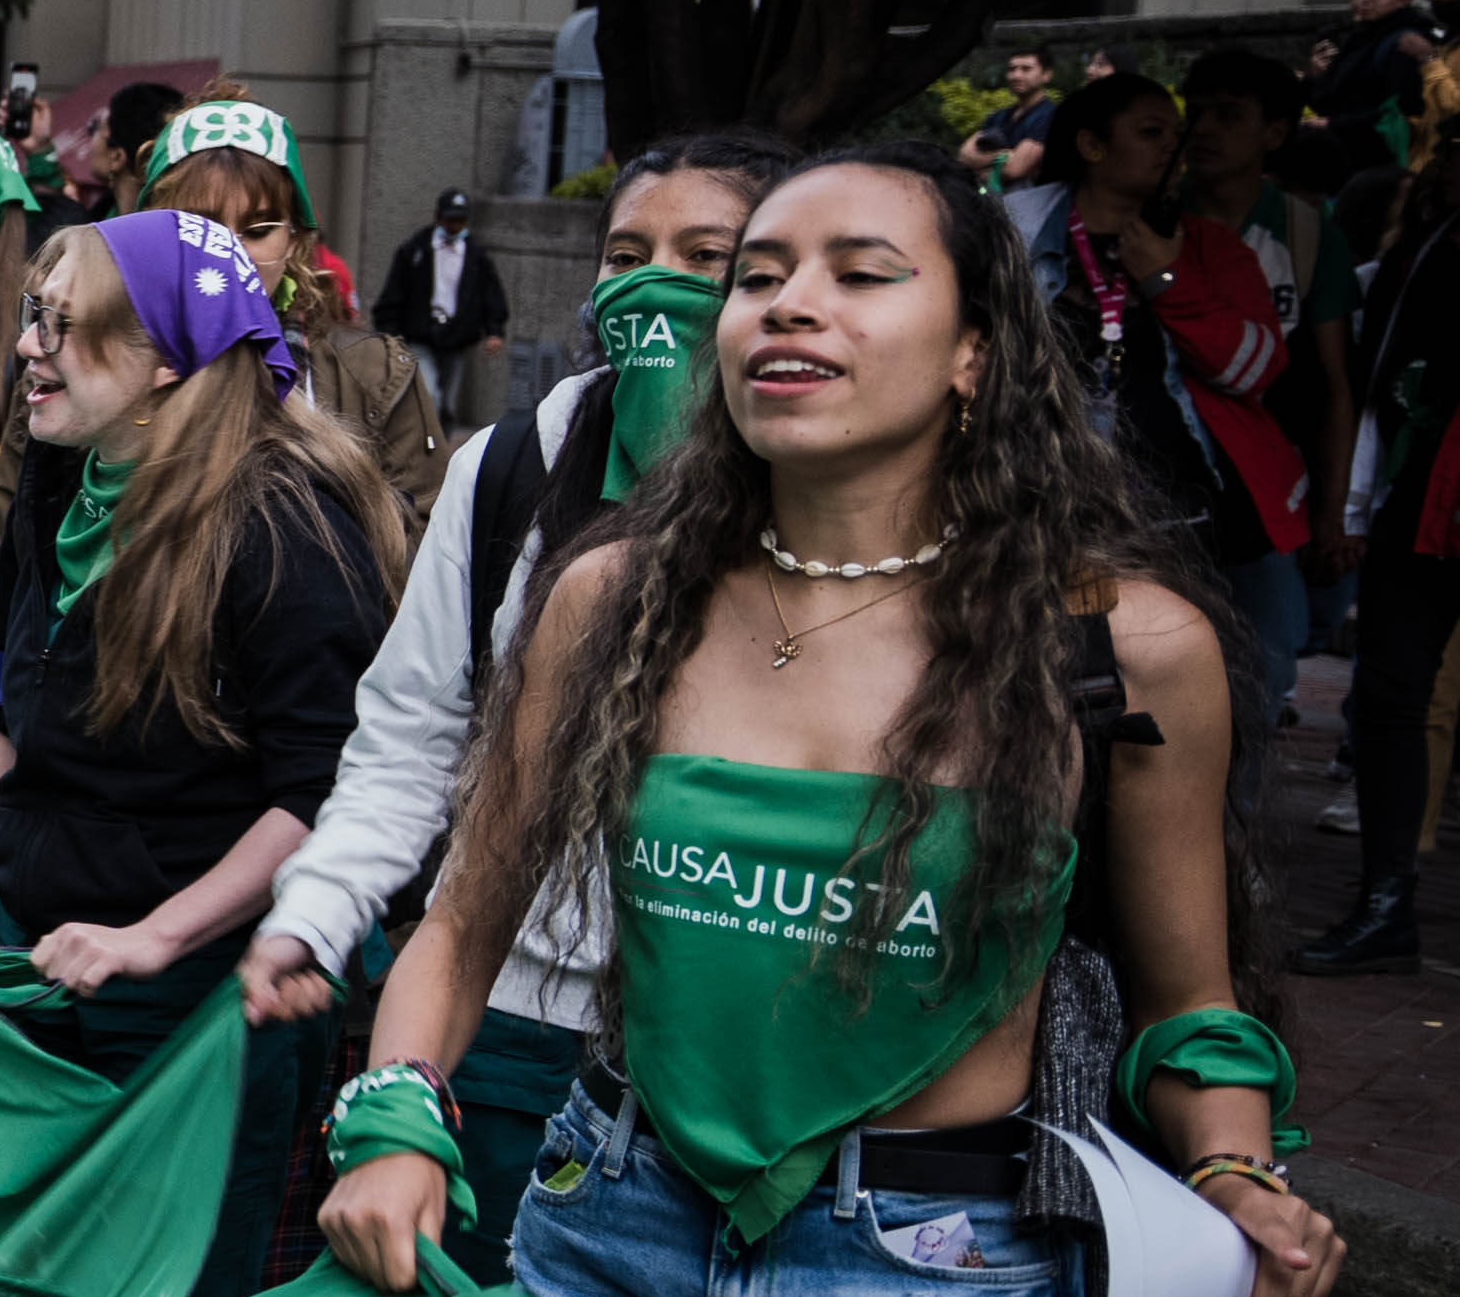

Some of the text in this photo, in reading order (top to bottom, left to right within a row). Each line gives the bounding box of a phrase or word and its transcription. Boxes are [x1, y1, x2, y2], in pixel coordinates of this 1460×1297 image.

[632, 354, 676, 369] aborto
[635, 894, 645, 910] la
[647, 899, 741, 930] eliminación
[747, 916, 776, 936] del
[783, 922, 838, 946] delito
[875, 938, 937, 959] aborto
